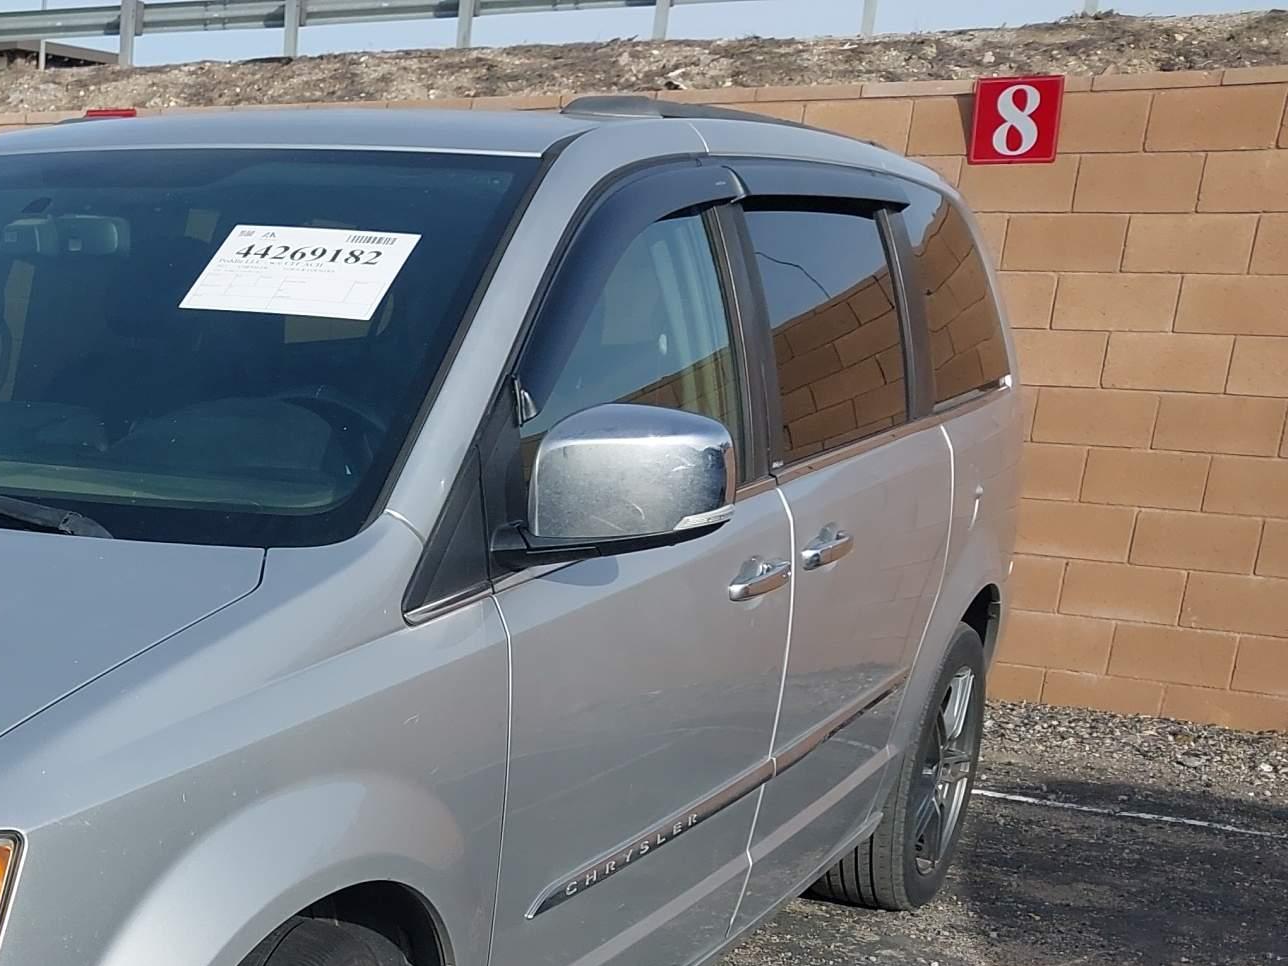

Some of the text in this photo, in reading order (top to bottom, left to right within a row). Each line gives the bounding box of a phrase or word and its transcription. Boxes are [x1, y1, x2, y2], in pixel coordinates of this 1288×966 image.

[992, 84, 1041, 156] 8
[235, 243, 383, 266] 44269182
[565, 813, 699, 896] CHRYSLER
